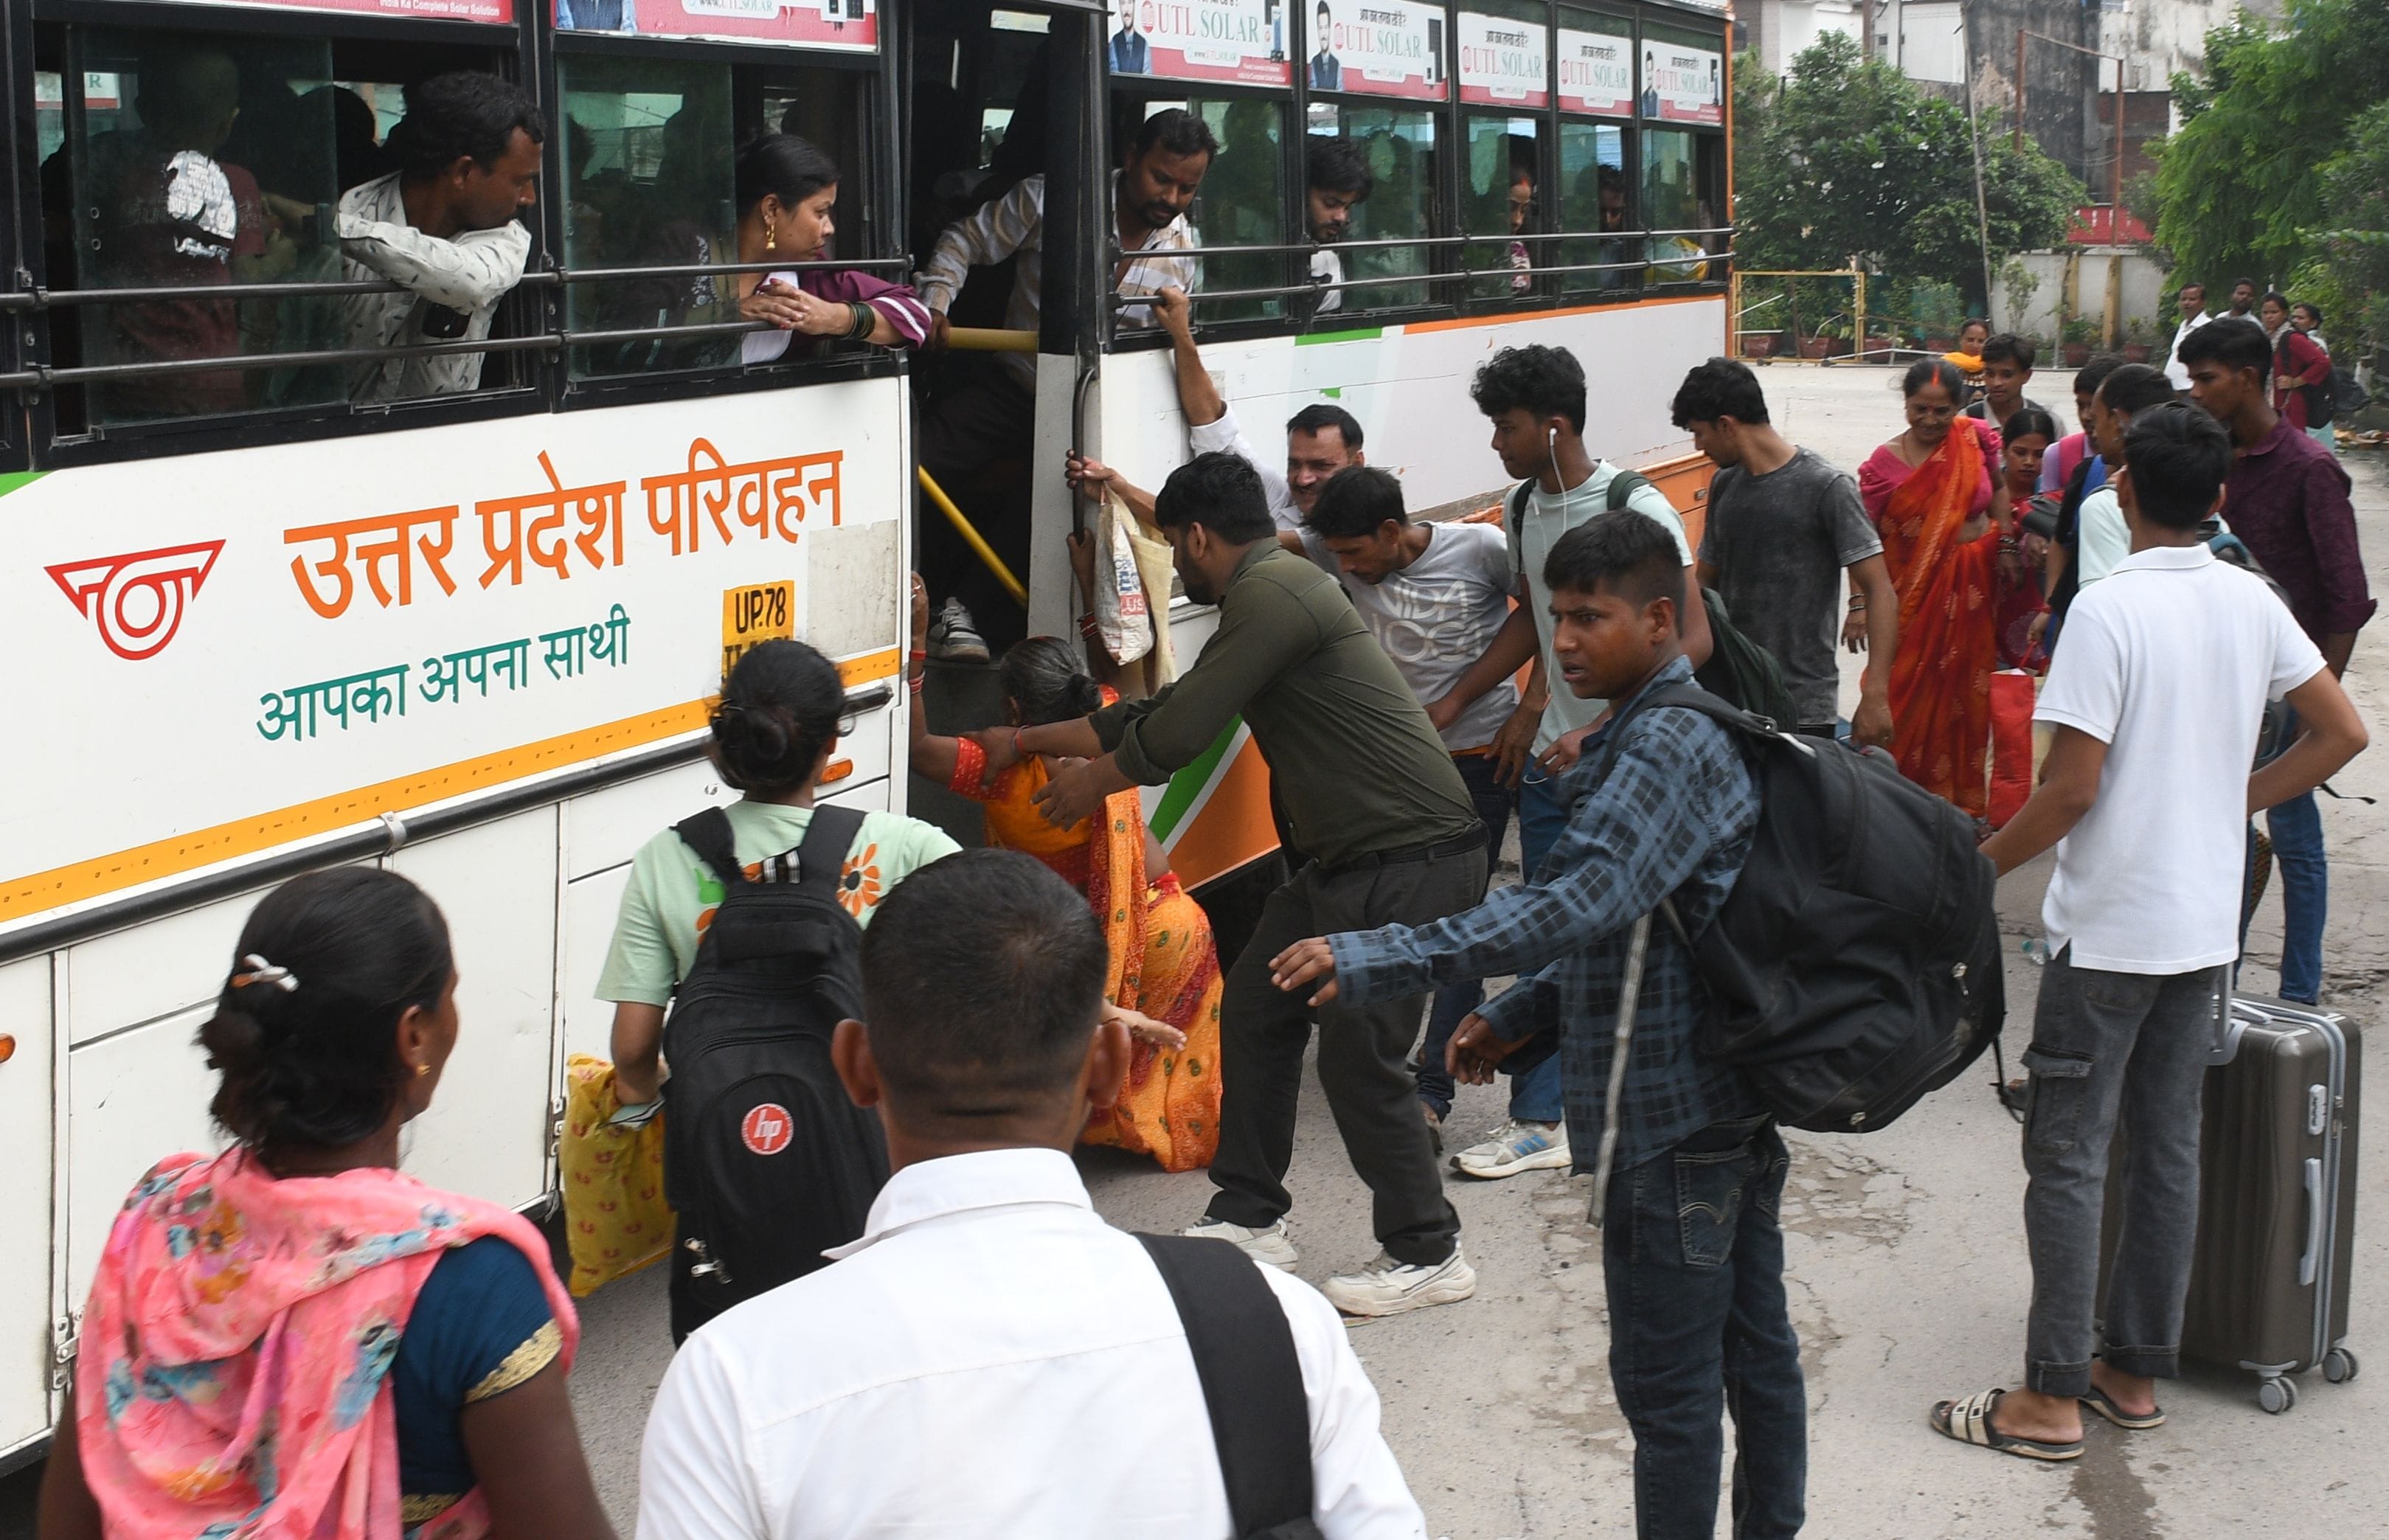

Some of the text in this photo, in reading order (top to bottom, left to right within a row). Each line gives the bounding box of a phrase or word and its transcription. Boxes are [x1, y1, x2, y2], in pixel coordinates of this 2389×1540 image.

[412, 1, 449, 13] Complete
[450, 3, 469, 14] Solar
[471, 5, 500, 16] Solution
[1158, 4, 1259, 43] UTL SOLAR
[1345, 24, 1421, 58] UTL SOLAR
[1473, 47, 1542, 79] UTL SOLAR
[1570, 61, 1628, 89] UTL SOLAR
[284, 437, 843, 620] उत्तर प्रदेश परिवहन
[735, 586, 786, 634] UP.78
[257, 603, 631, 741] आपका अपना साथी
[752, 1109, 783, 1150] hp
